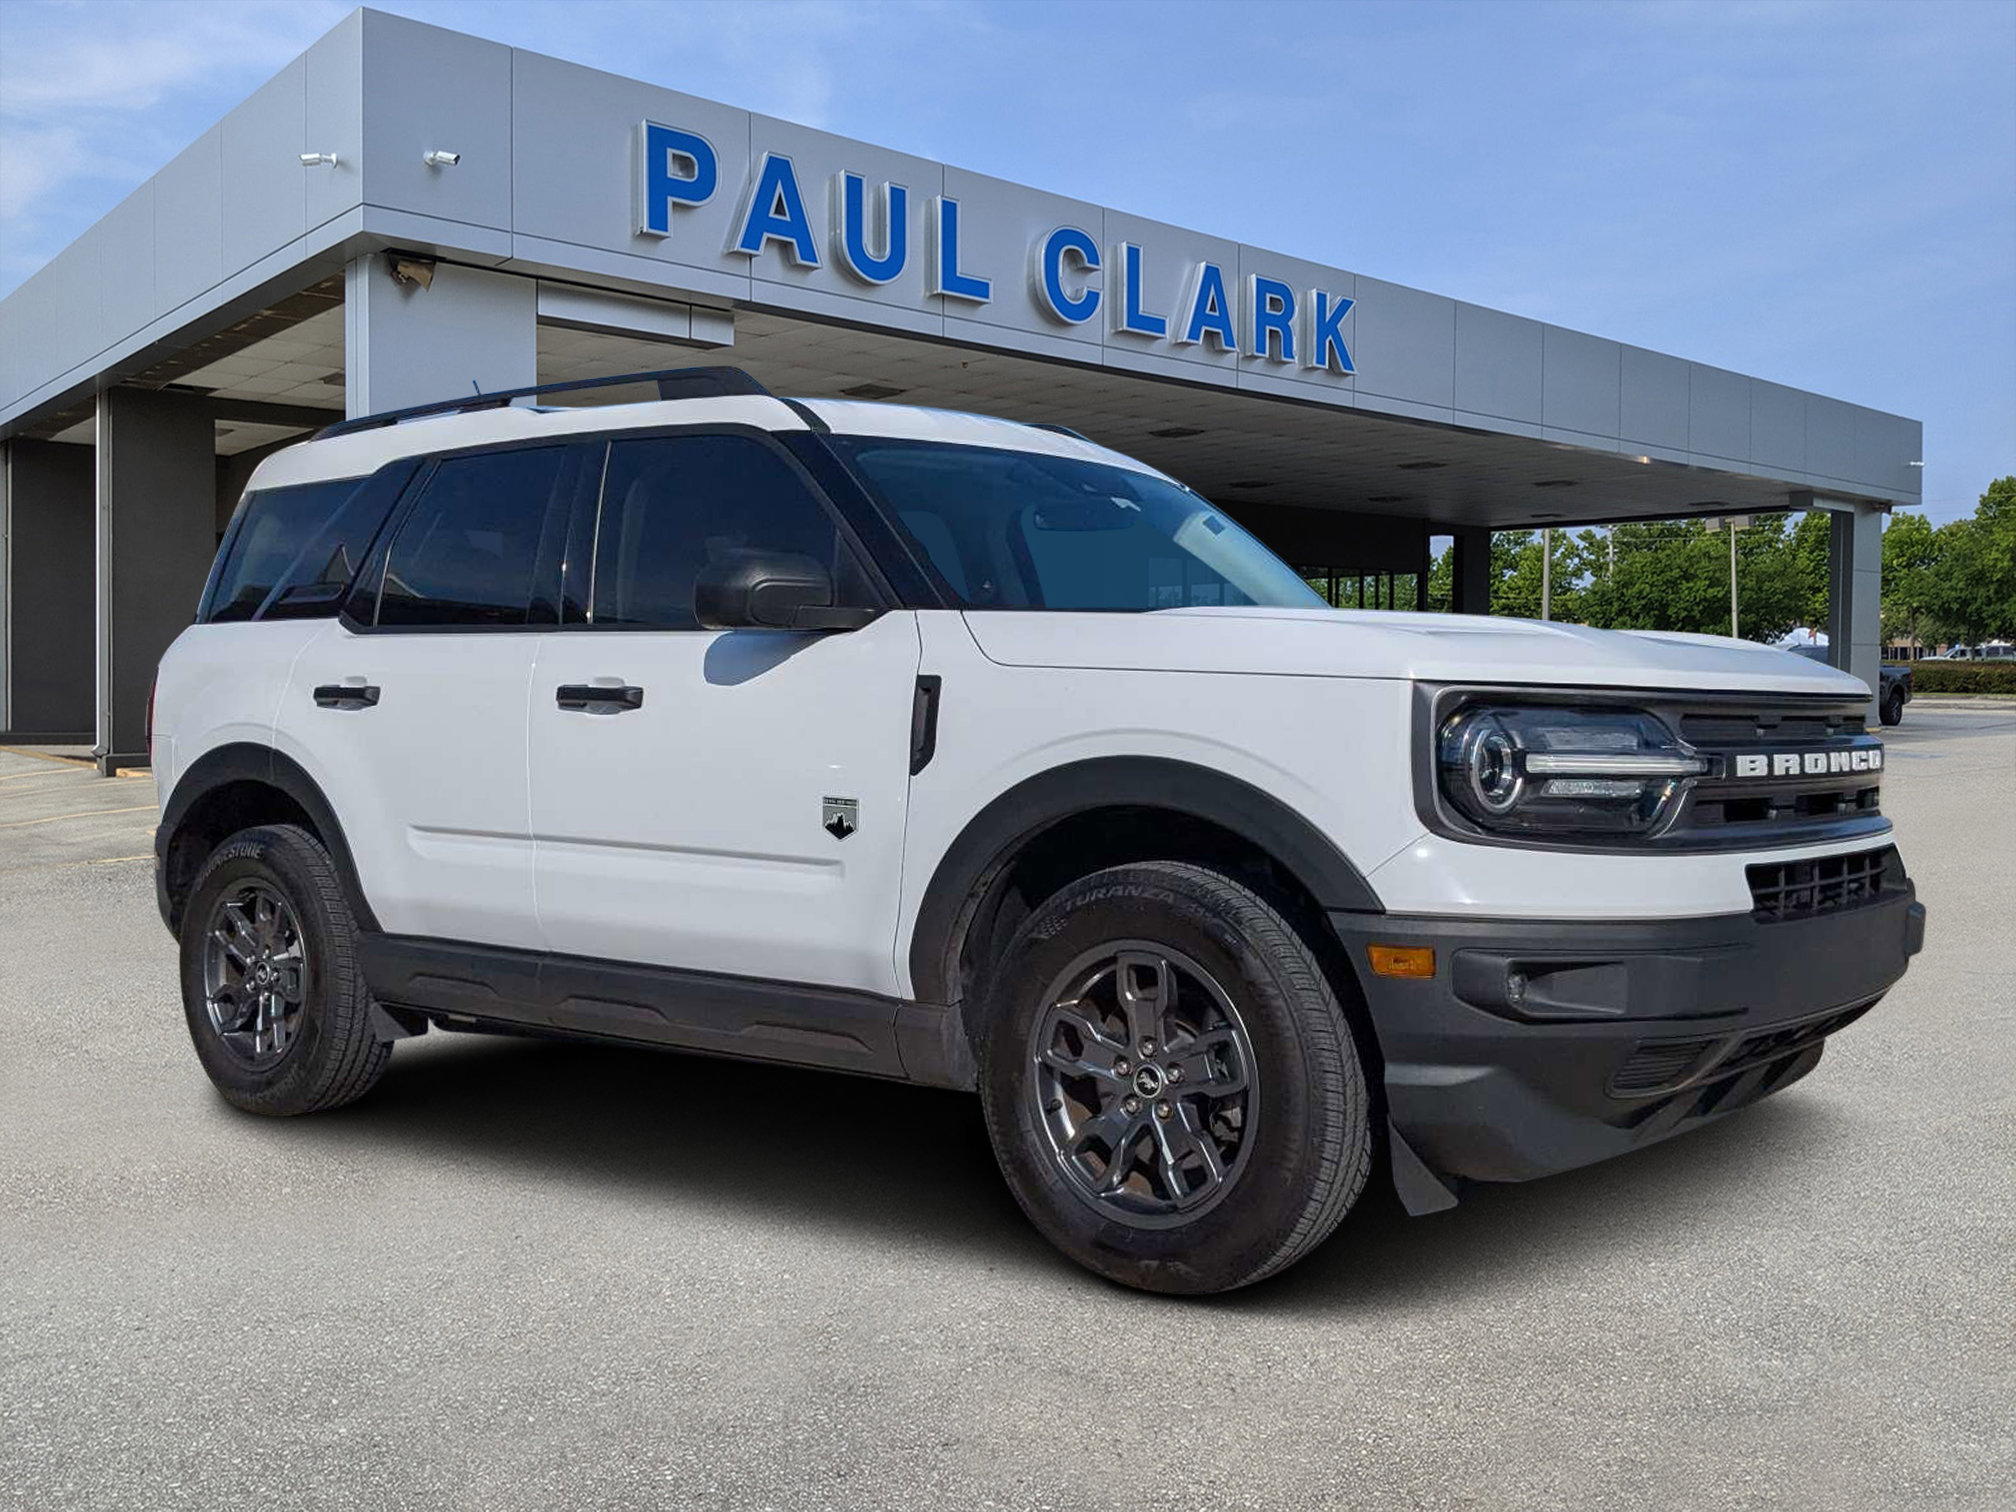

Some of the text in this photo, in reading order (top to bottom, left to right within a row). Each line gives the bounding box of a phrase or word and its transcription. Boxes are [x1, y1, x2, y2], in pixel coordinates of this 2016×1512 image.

[641, 119, 1357, 375] PAUL CLARK
[1736, 750, 1882, 777] BRONCO
